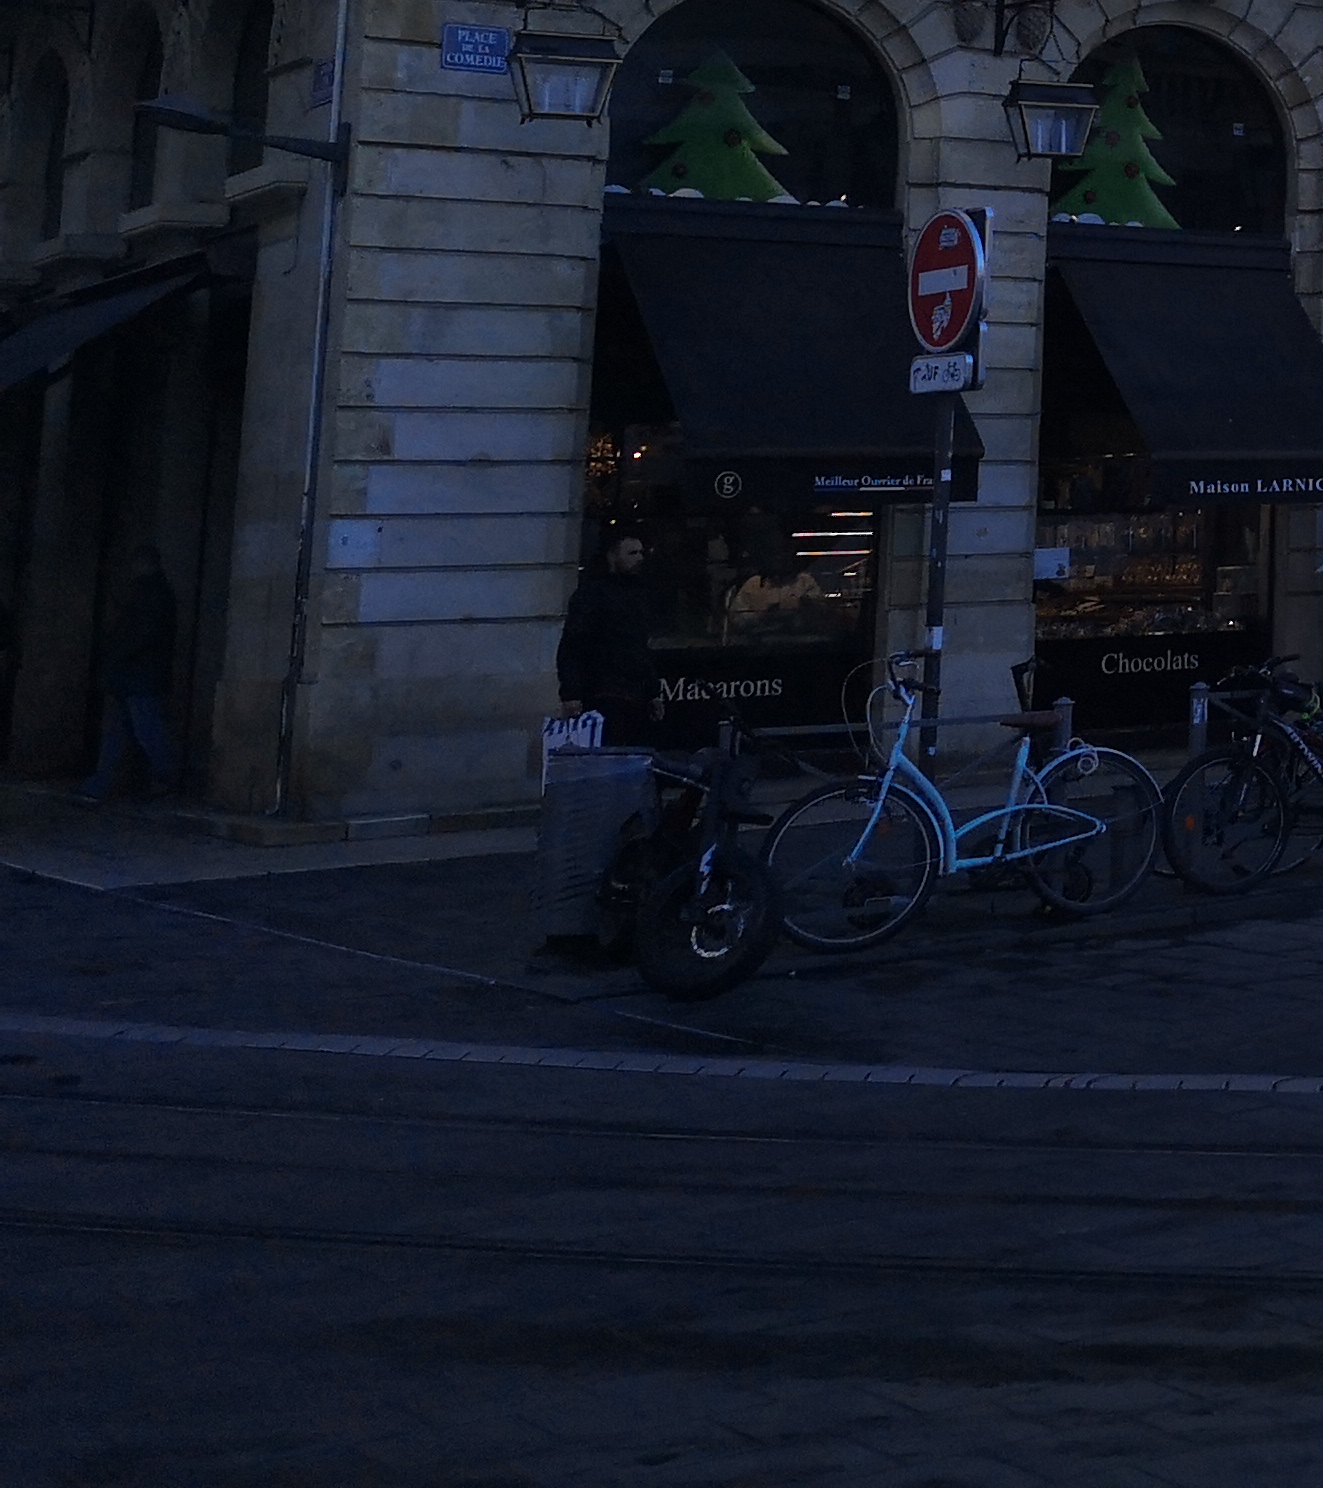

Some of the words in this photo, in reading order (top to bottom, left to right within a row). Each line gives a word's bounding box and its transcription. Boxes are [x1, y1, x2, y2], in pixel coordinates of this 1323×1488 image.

[458, 29, 497, 44] PLACE
[814, 474, 860, 487] Meilleur
[861, 474, 902, 487] Ouvrier
[902, 474, 915, 486] de
[916, 474, 934, 486] Fra
[1189, 479, 1250, 495] Maison
[1101, 649, 1200, 675] Chocolats
[658, 676, 783, 702] Macarons
